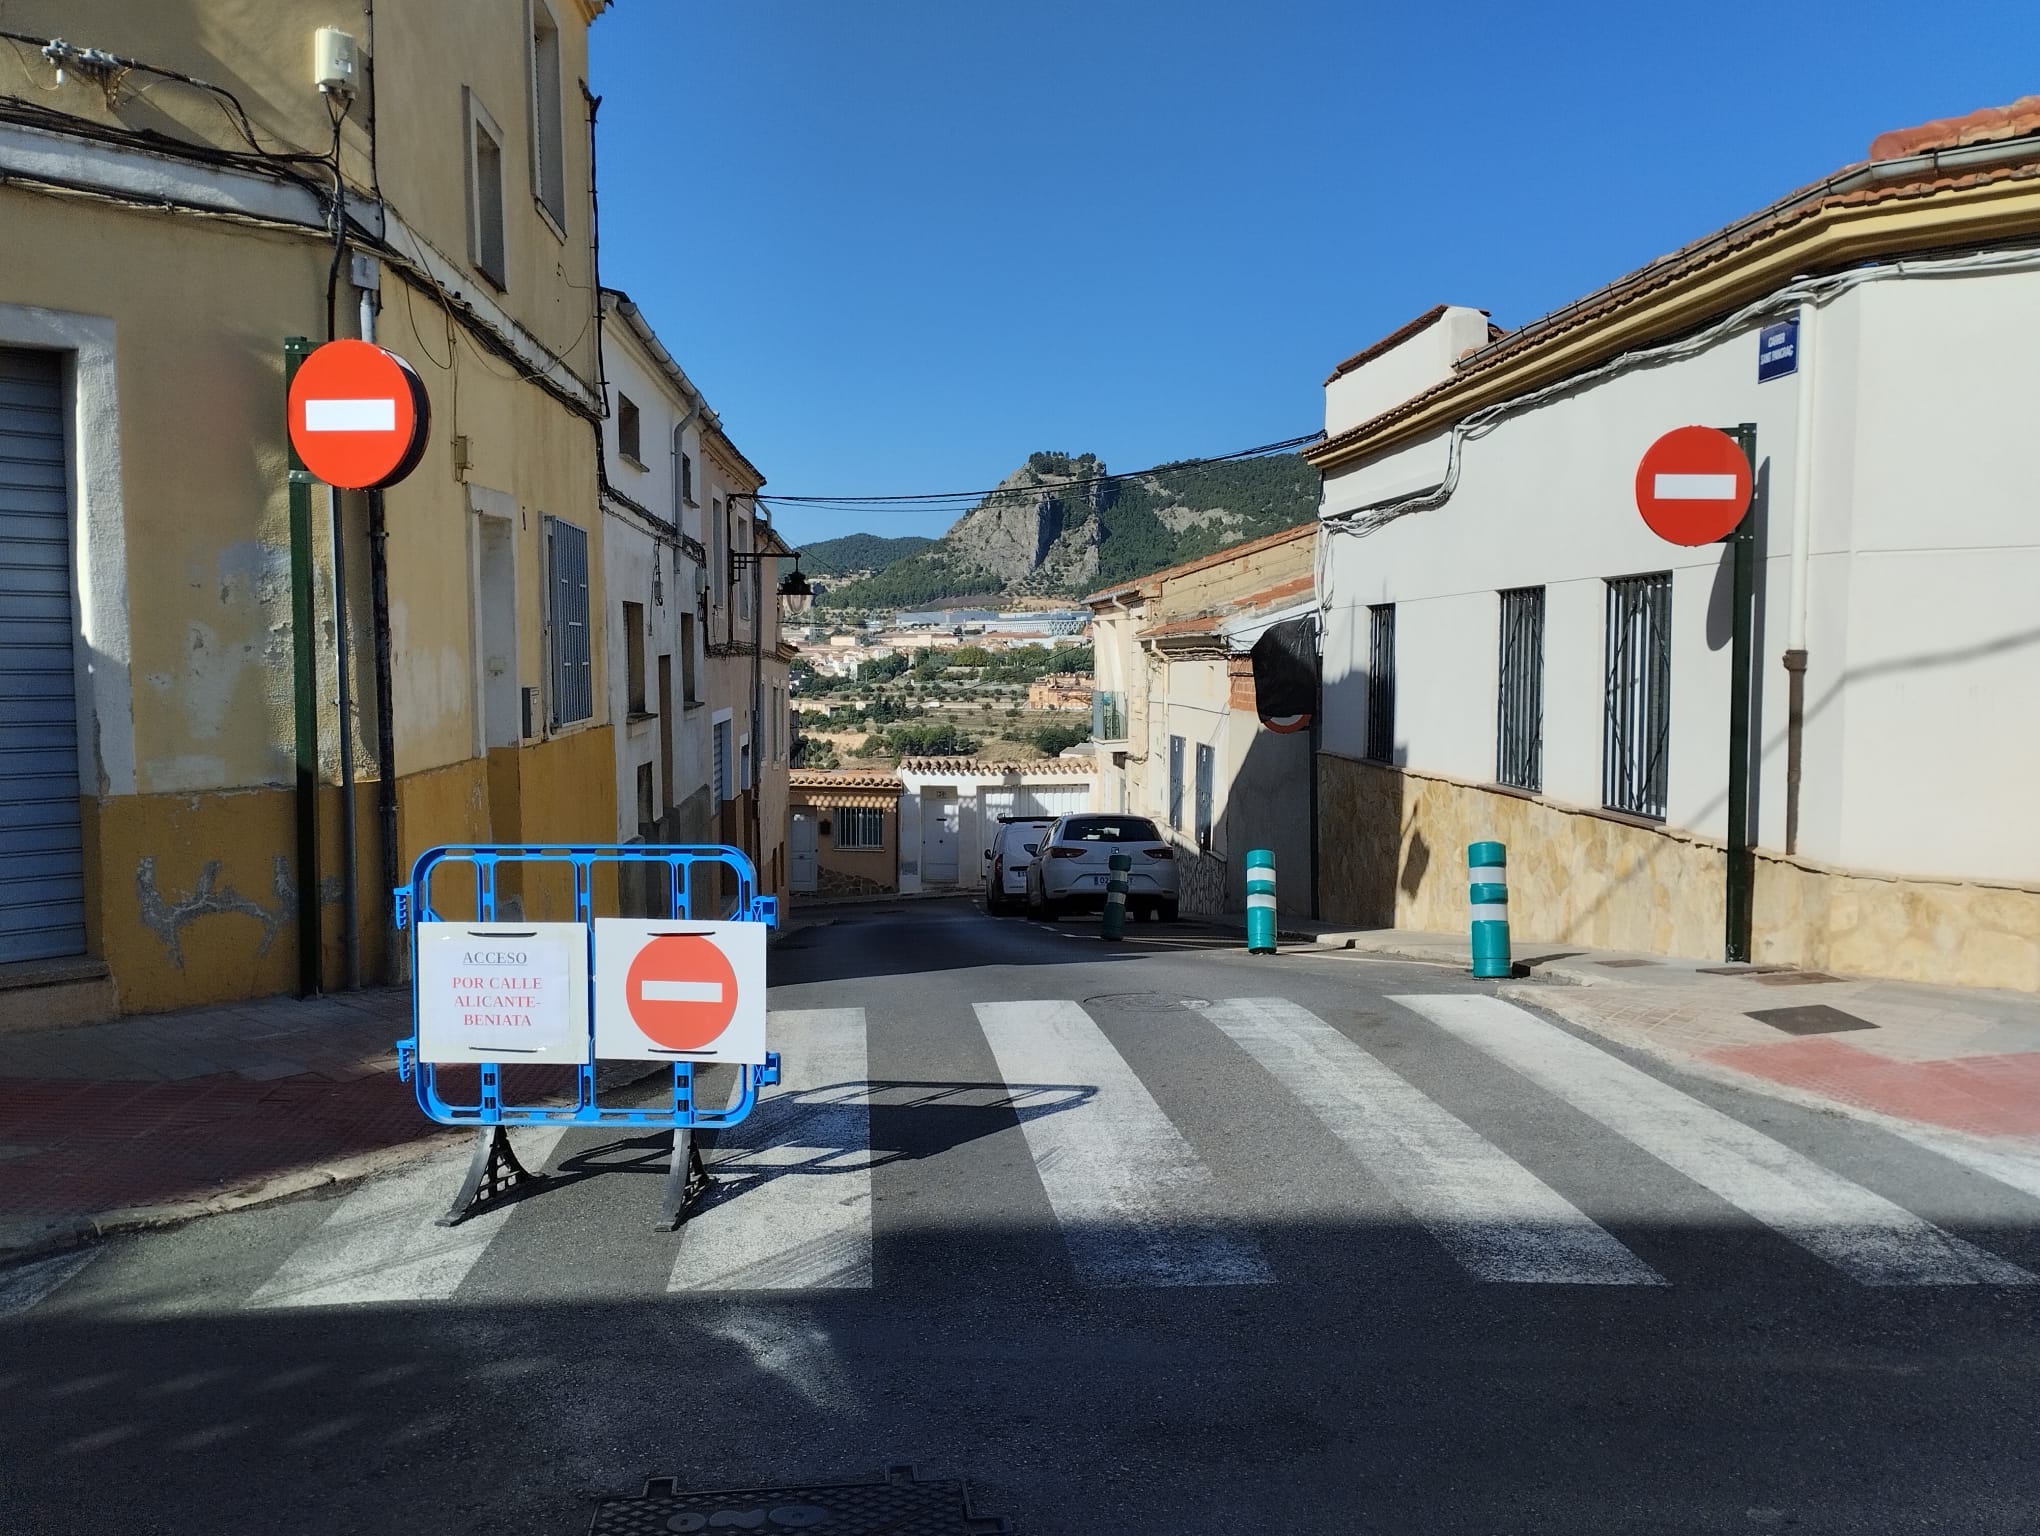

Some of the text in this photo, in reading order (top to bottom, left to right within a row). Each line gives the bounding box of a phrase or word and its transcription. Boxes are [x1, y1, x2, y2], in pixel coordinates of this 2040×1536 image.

[463, 951, 528, 965] ACCESO
[452, 977, 543, 989] POR CALLE
[454, 995, 541, 1007] ALICANTE-
[463, 1014, 532, 1026] BENIATA
